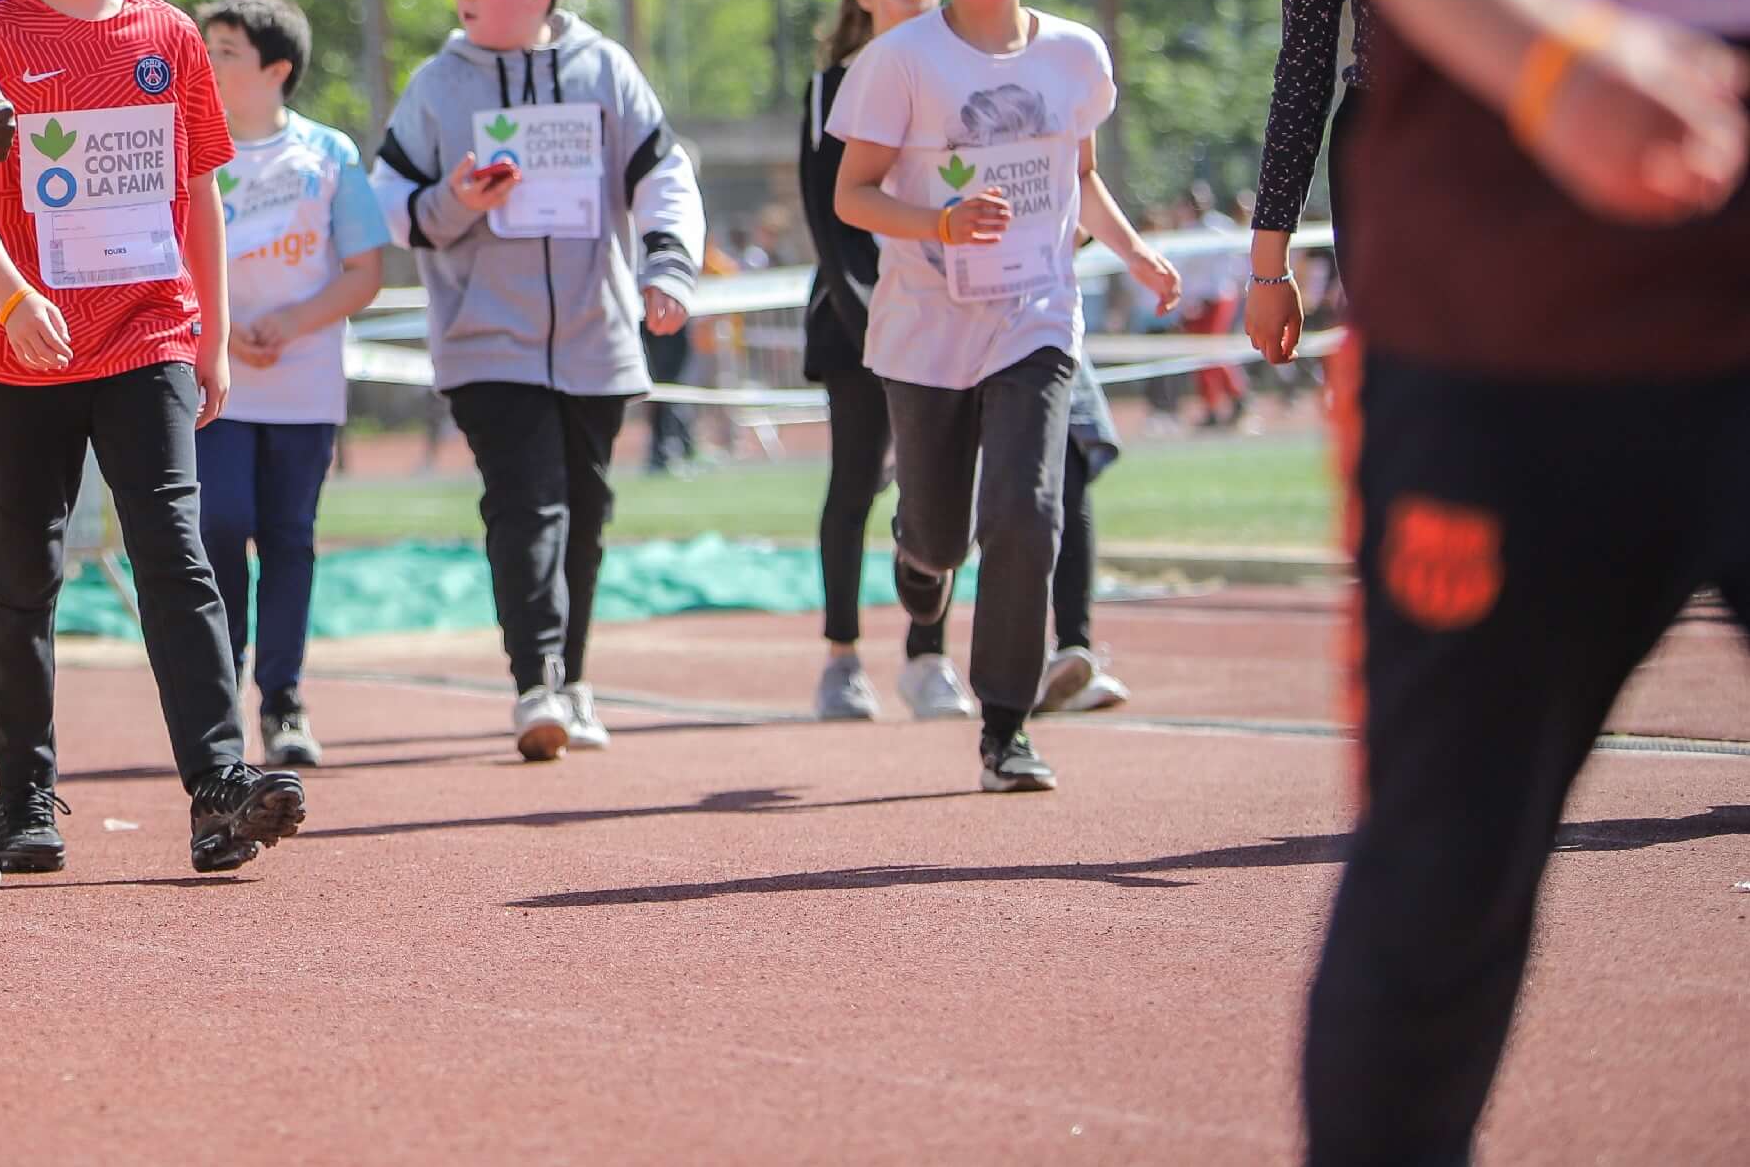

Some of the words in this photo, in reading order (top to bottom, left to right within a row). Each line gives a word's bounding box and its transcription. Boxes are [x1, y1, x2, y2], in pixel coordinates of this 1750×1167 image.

[84, 128, 164, 153] ACTION
[84, 151, 164, 175] CONTRE
[983, 157, 1051, 183] ACTION
[86, 176, 114, 197] LA
[118, 171, 164, 194] FAIM
[990, 176, 1051, 201] ONTRE
[104, 247, 127, 256] TOURS
